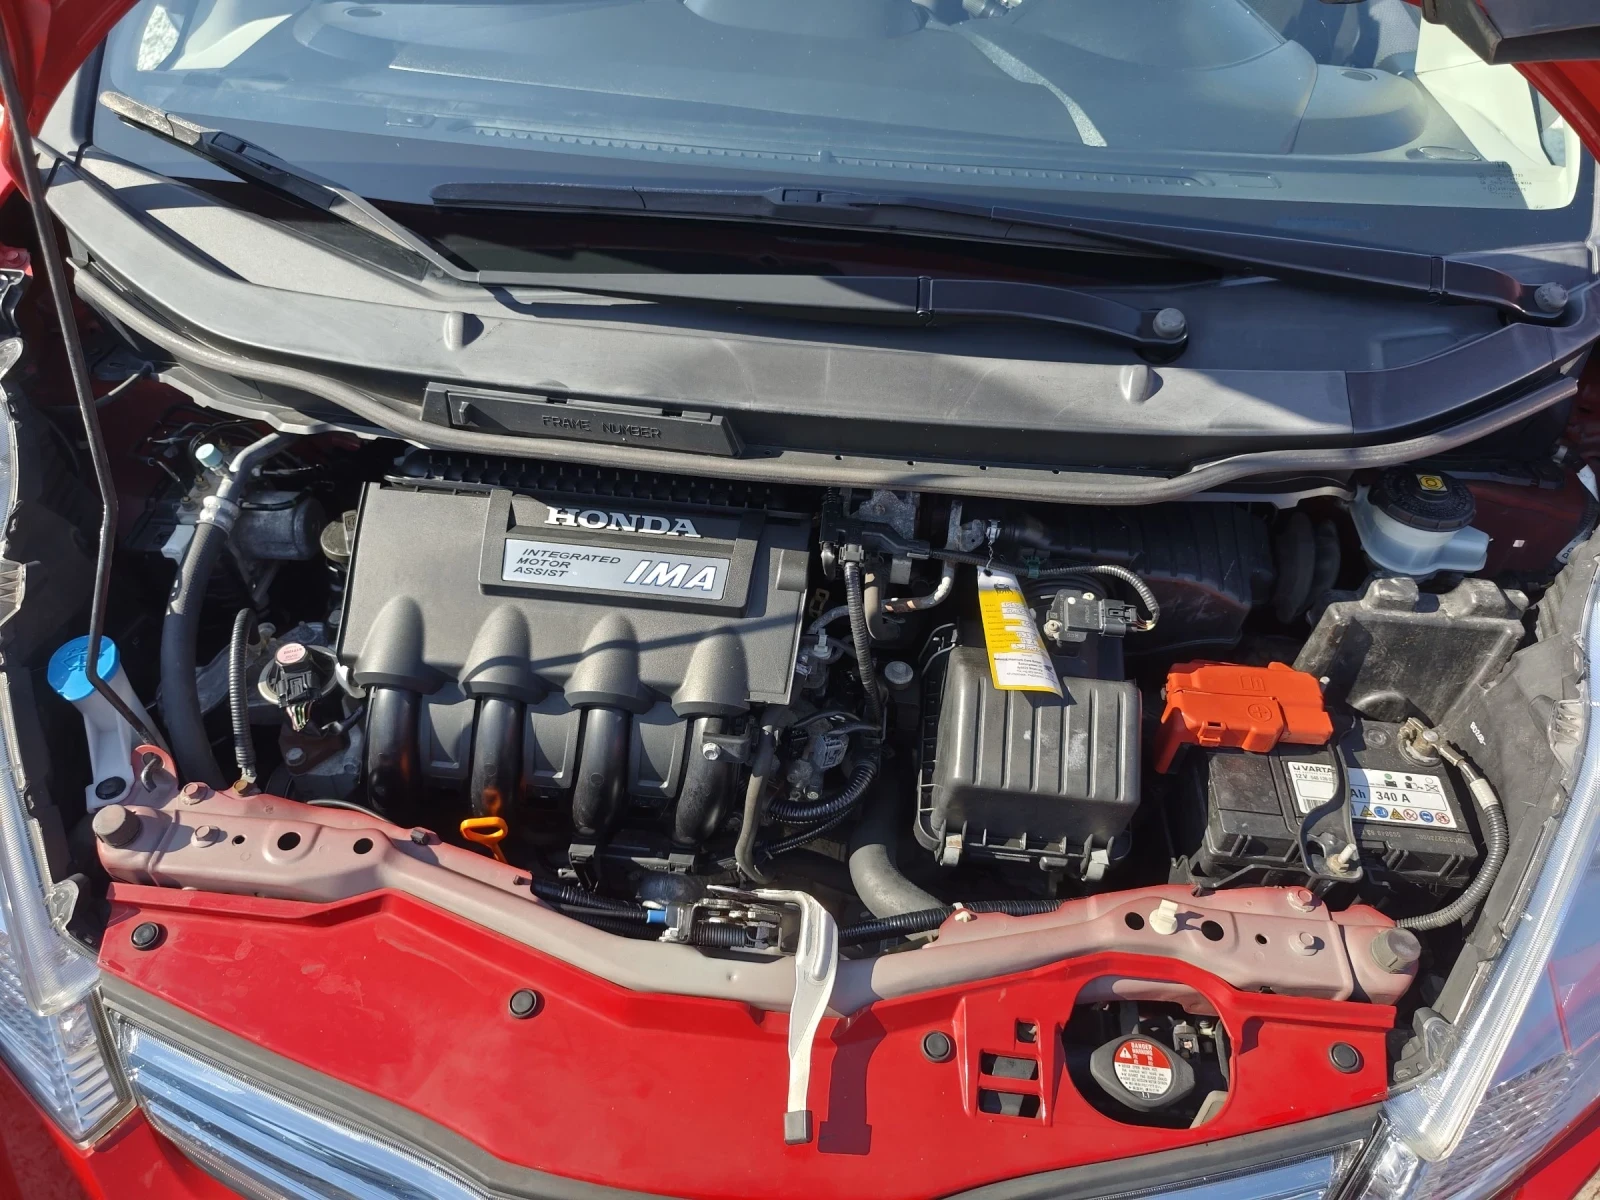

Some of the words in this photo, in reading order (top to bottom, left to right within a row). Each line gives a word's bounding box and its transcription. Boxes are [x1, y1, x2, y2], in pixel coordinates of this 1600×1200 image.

[542, 415, 591, 432] FRAME
[602, 422, 662, 439] NUMBER
[544, 505, 702, 538] HONDA
[516, 557, 571, 569] MOTOR
[522, 548, 621, 564] INTEGRATED
[513, 566, 569, 578] ASSIST
[623, 559, 718, 592] IMA
[1301, 765, 1334, 774] VARTA
[1350, 788, 1366, 799] Ah
[1376, 791, 1398, 802] 340
[1401, 793, 1411, 803] A
